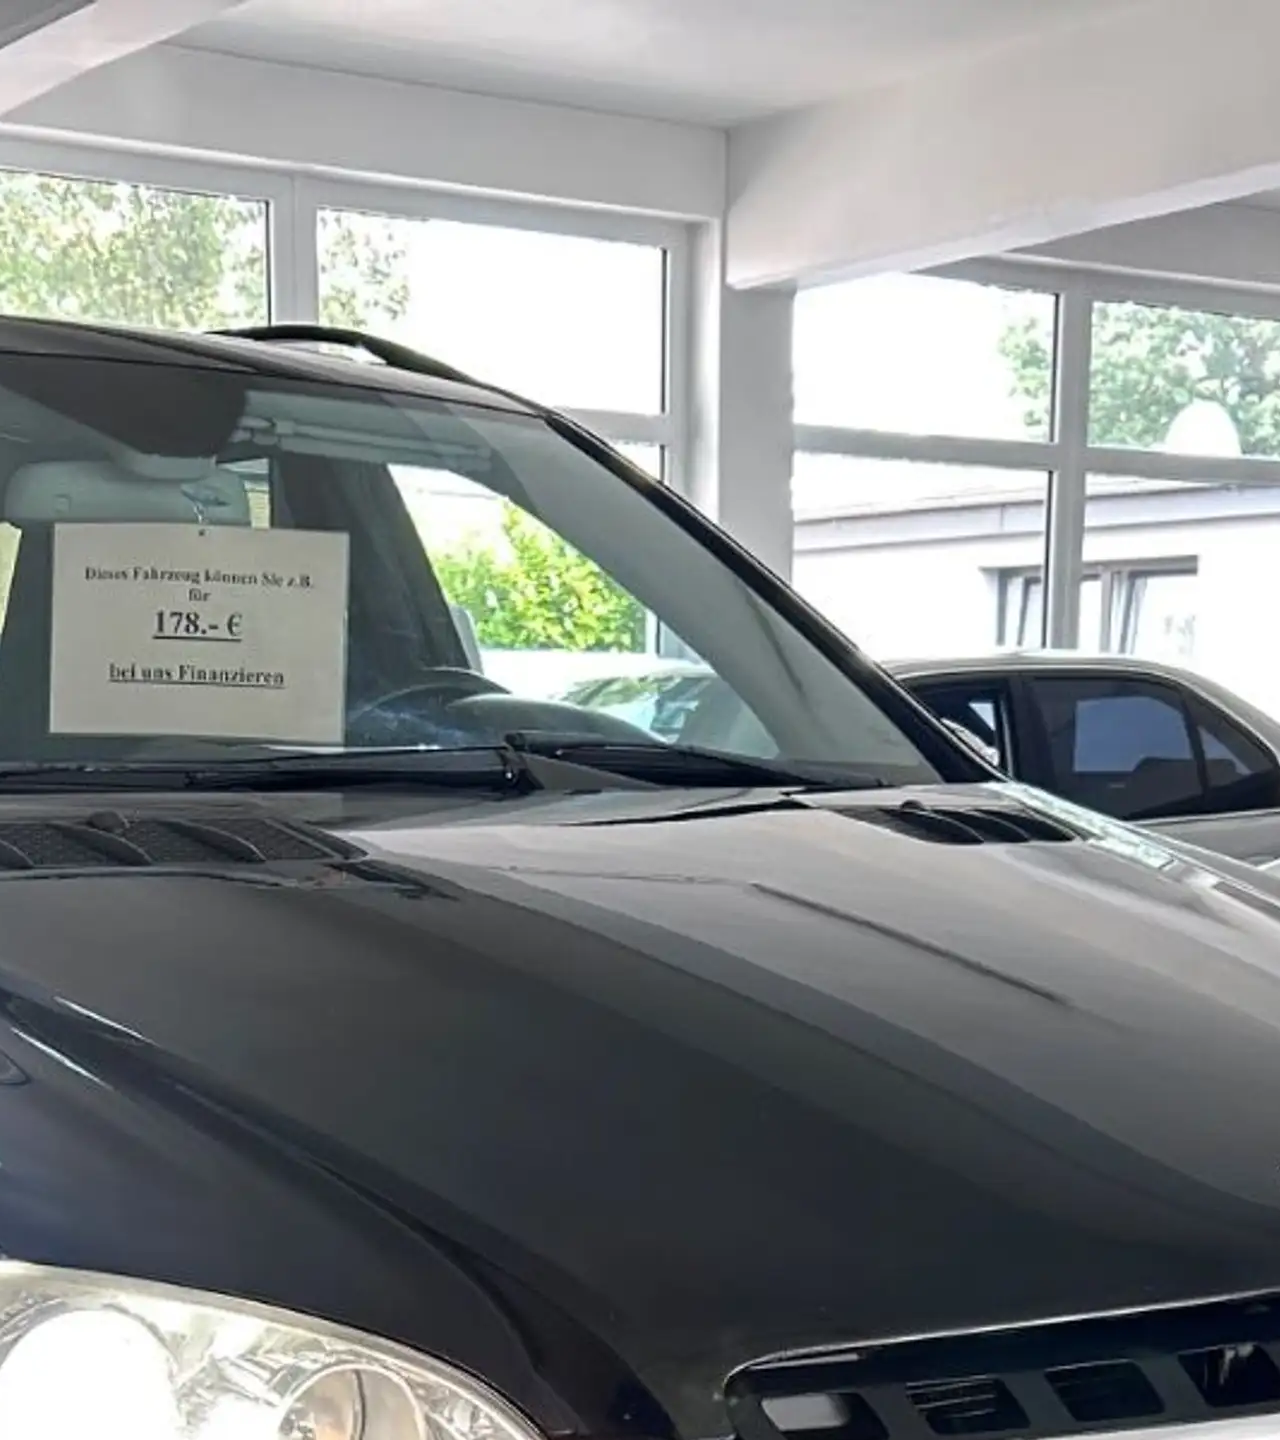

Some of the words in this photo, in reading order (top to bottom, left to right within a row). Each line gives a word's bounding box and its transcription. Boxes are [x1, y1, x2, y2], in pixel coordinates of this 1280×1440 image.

[133, 566, 200, 585] Fahrzeug
[204, 569, 258, 585] können
[188, 587, 211, 602] für
[226, 611, 243, 637] €
[110, 663, 136, 681] bei
[141, 666, 171, 681] uns
[178, 664, 285, 686] Finanzieren
